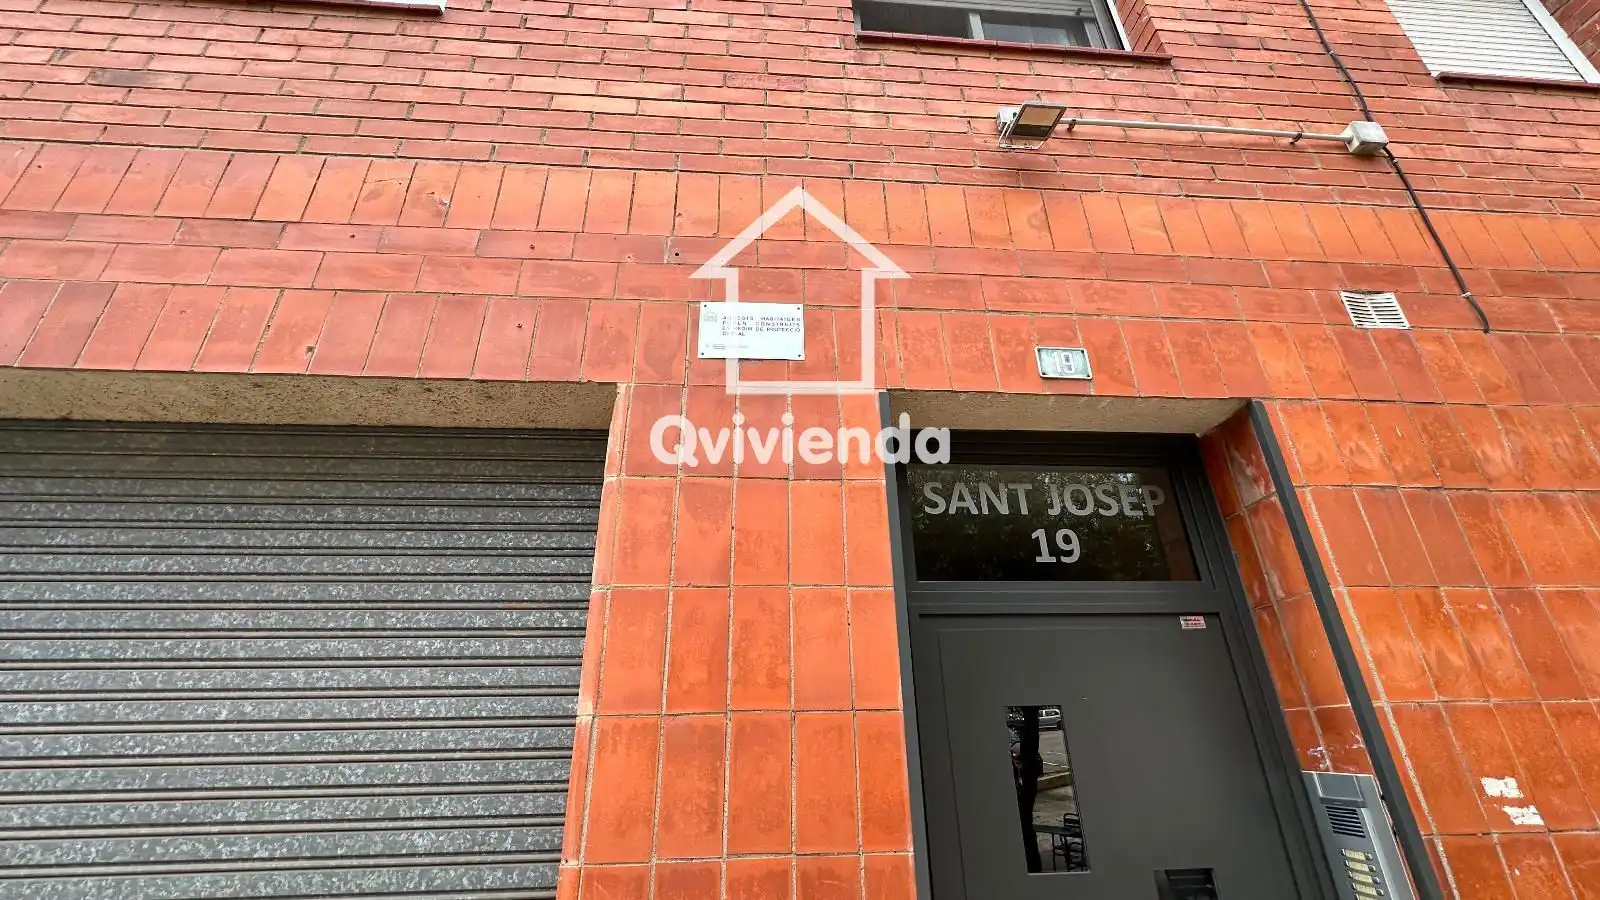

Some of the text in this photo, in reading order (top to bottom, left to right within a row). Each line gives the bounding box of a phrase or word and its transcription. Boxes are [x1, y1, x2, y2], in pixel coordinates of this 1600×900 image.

[1051, 351, 1076, 374] 19
[922, 481, 1166, 517] SANT JOSEP
[1031, 528, 1081, 564] 19
